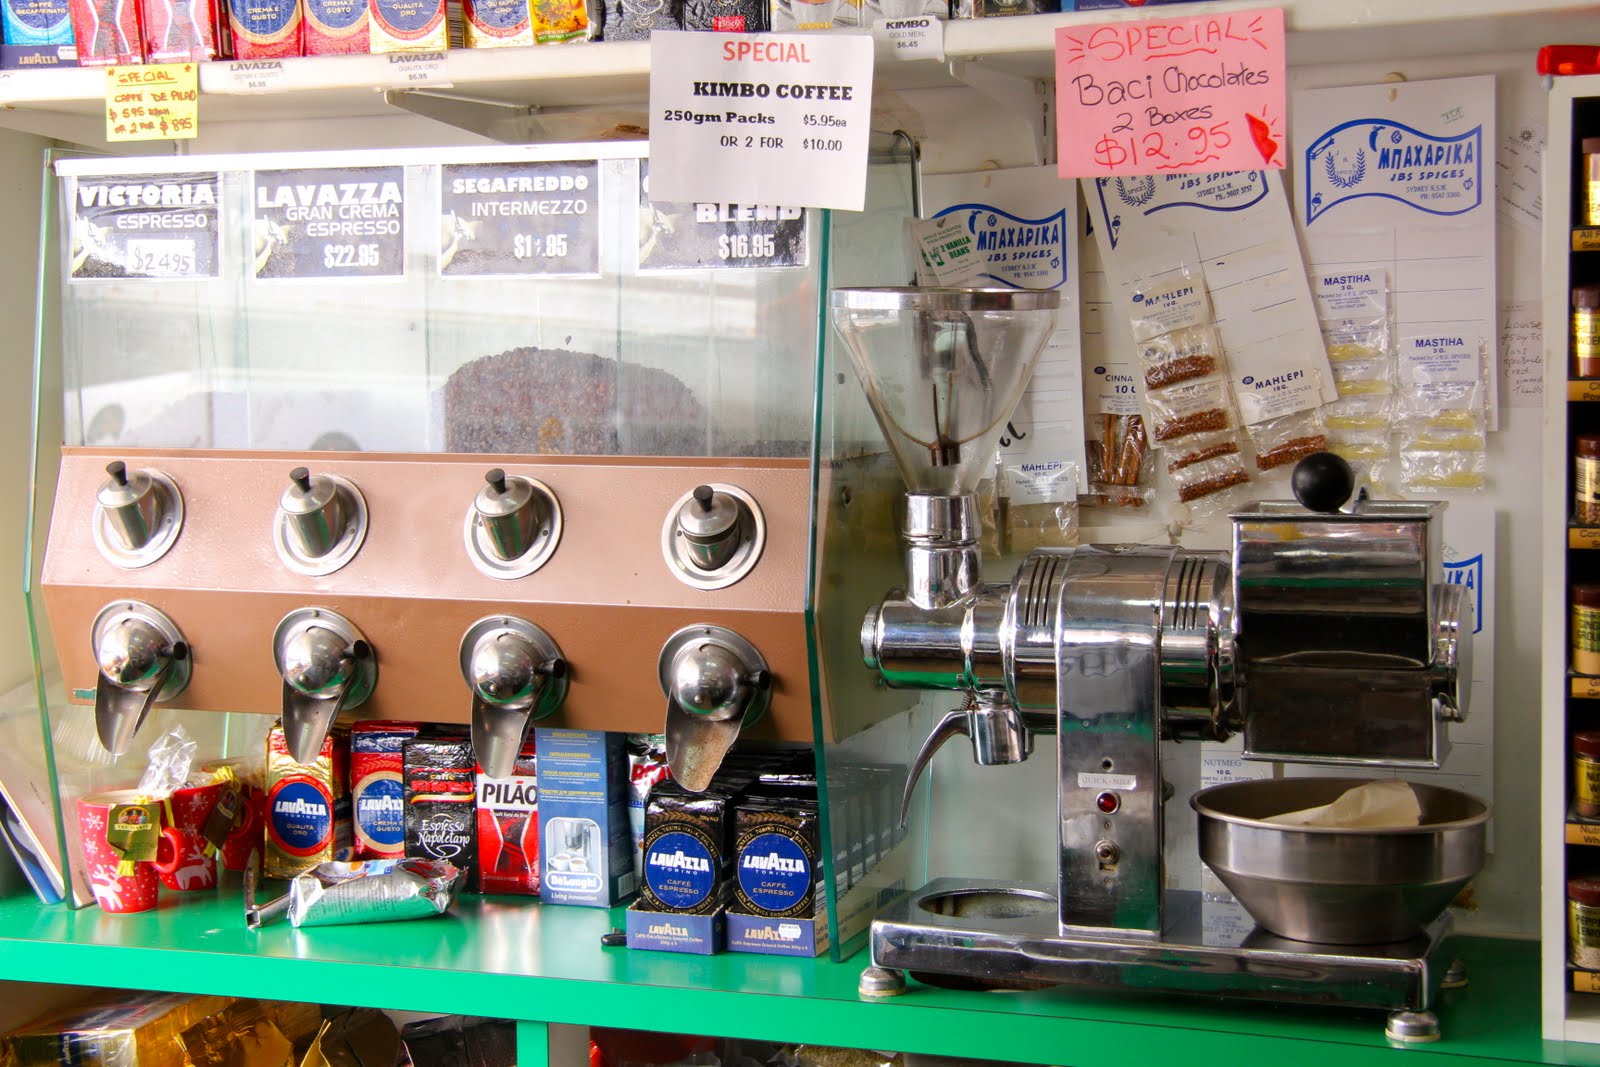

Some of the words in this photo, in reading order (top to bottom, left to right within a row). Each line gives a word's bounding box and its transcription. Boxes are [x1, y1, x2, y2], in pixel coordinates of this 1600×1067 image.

[885, 20, 930, 30] KIMBO
[896, 41, 918, 49] $6.45
[1088, 17, 1248, 61] SPECIAL
[19, 53, 58, 65] LAVAZZA
[389, 53, 445, 63] LAVAZZA
[722, 41, 811, 63] SPECIAL
[230, 61, 283, 72] LAVAZZA
[118, 71, 175, 83] SPECIAL
[1072, 74, 1153, 106] Baci
[1163, 62, 1269, 94] Chocolates
[150, 92, 168, 102] DE
[693, 81, 770, 98] KIMBO
[776, 83, 853, 101] COFFEE
[664, 110, 722, 125] 250gm
[725, 112, 776, 125] Packs
[803, 114, 847, 128] $5.95ea
[1112, 113, 1134, 134] 2
[1145, 105, 1213, 127] Boxes
[720, 135, 738, 147] OR
[745, 136, 754, 148] 2
[760, 136, 784, 149] FOR
[802, 138, 843, 151] $10.00
[1094, 121, 1232, 170] $12.95
[1180, 177, 1201, 190] JBS
[1206, 170, 1245, 183] SPIC
[1390, 171, 1413, 182] JBS
[1419, 169, 1465, 180] SPICES
[452, 175, 589, 194] SEGAFREDDO
[78, 184, 216, 207] VICTORIA
[257, 182, 403, 208] LAVAZZA
[286, 206, 333, 221] GRAN
[338, 203, 400, 219] CREMA
[471, 199, 588, 217] INTERMEZZO
[116, 214, 208, 229] ESPRESSO
[306, 220, 400, 237] ESPRESSO
[718, 233, 775, 260] $16.95
[940, 244, 946, 252] 2
[945, 235, 972, 250] VANILLA
[323, 243, 379, 269] $22.95
[948, 246, 971, 259] BEANS
[987, 253, 1007, 262] JBS
[1012, 249, 1052, 260] SPICES
[1324, 274, 1371, 286] MASTIHA
[1415, 338, 1464, 347] MASTIHA
[1105, 374, 1134, 382] CINNA
[1255, 370, 1304, 390] MAHLEPI
[1115, 385, 1128, 393] 10
[1022, 461, 1062, 472] MAHLEPI
[1203, 759, 1242, 767] NUTMEG
[482, 781, 537, 806] PILÃO
[275, 798, 327, 816] LAVAZZA
[360, 795, 404, 811] LAVAZZ
[421, 819, 465, 833] Espresso
[416, 830, 471, 846] Napoletano
[649, 850, 710, 872] LAVAZZA
[743, 852, 805, 873] LAVAZZA
[661, 866, 698, 875] TORINO
[756, 869, 793, 877] TORINO
[551, 892, 568, 901] Living
[568, 893, 597, 901] innovation
[658, 884, 699, 895] ESPRESSO
[753, 887, 795, 896] ESPRESSO
[747, 901, 769, 916] ARABICA
[792, 896, 810, 913] COFFEE
[649, 923, 689, 937] LAVAZZA
[744, 926, 794, 942] LAVAZ
